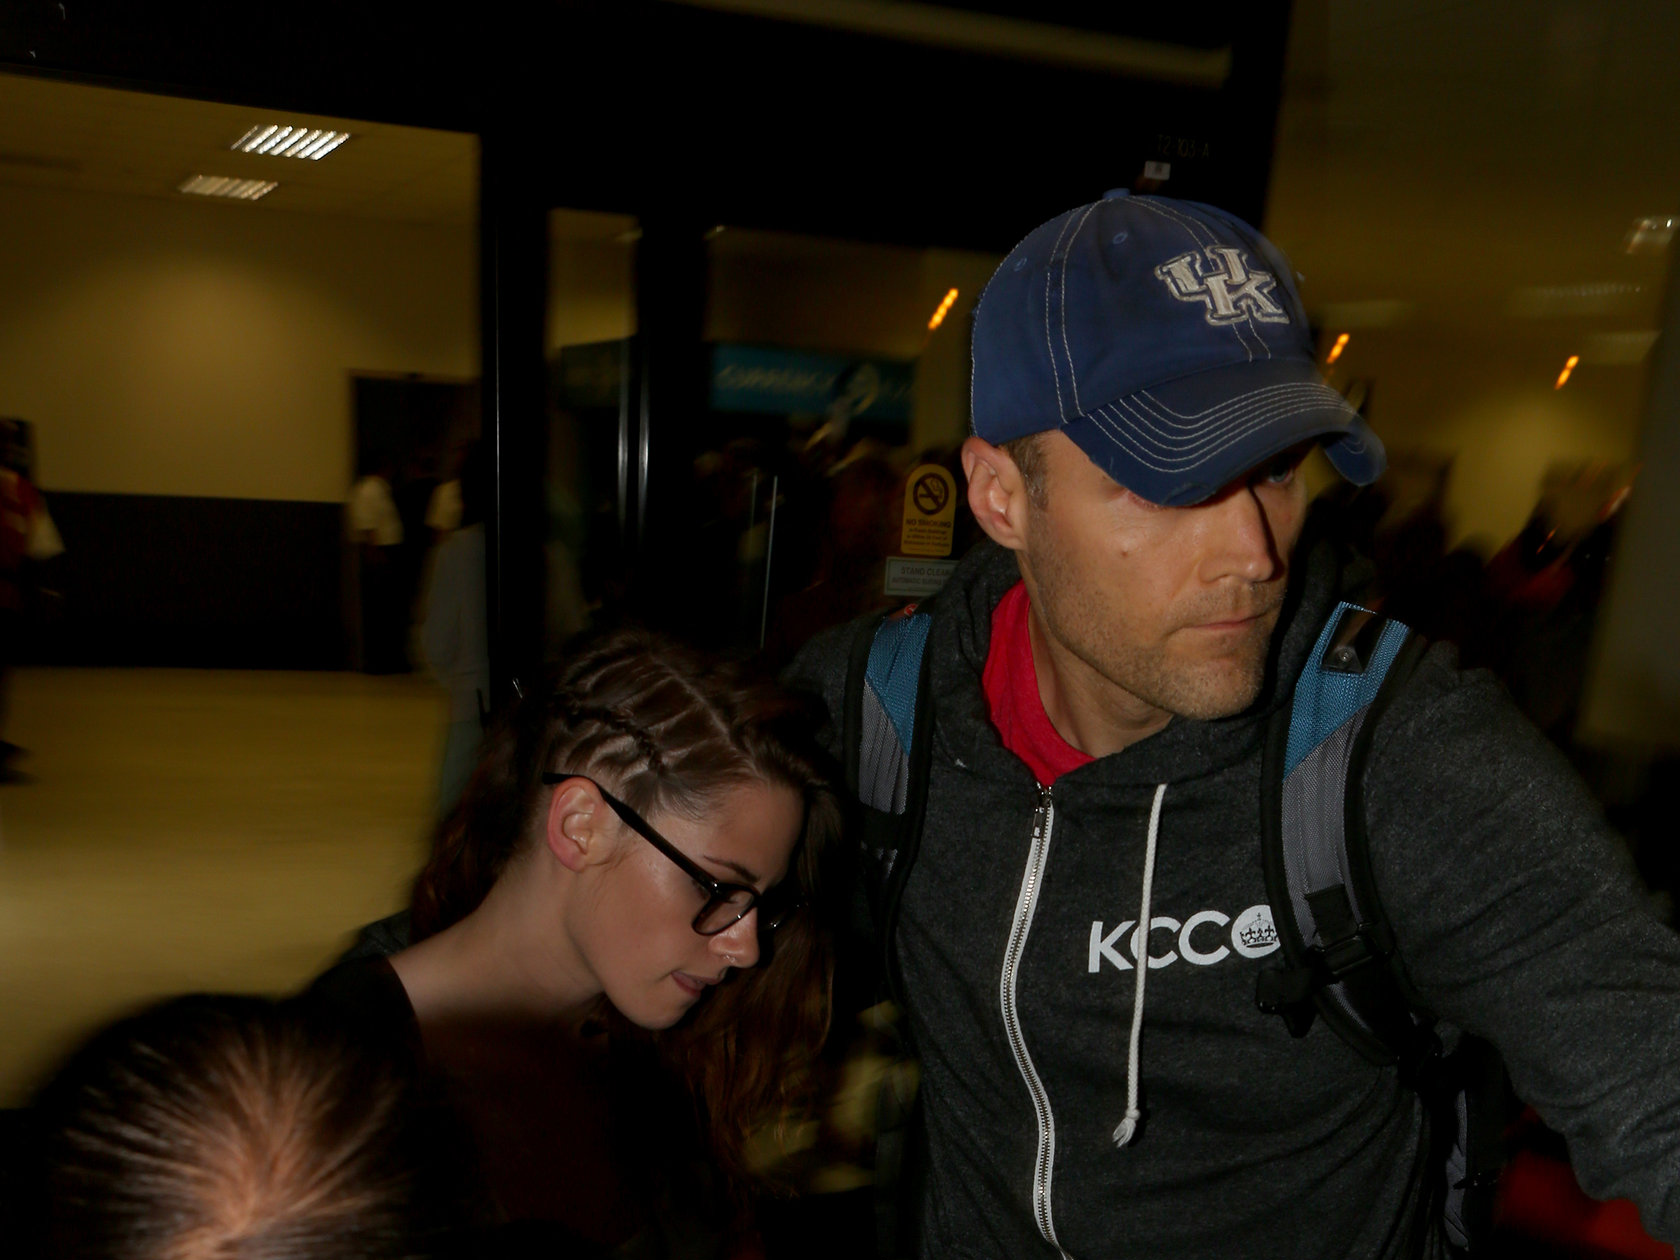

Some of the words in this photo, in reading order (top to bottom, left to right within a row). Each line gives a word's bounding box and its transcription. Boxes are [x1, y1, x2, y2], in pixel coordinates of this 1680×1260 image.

[1154, 245, 1290, 326] UK
[918, 519, 952, 528] SMOKING
[901, 566, 925, 576] STAND
